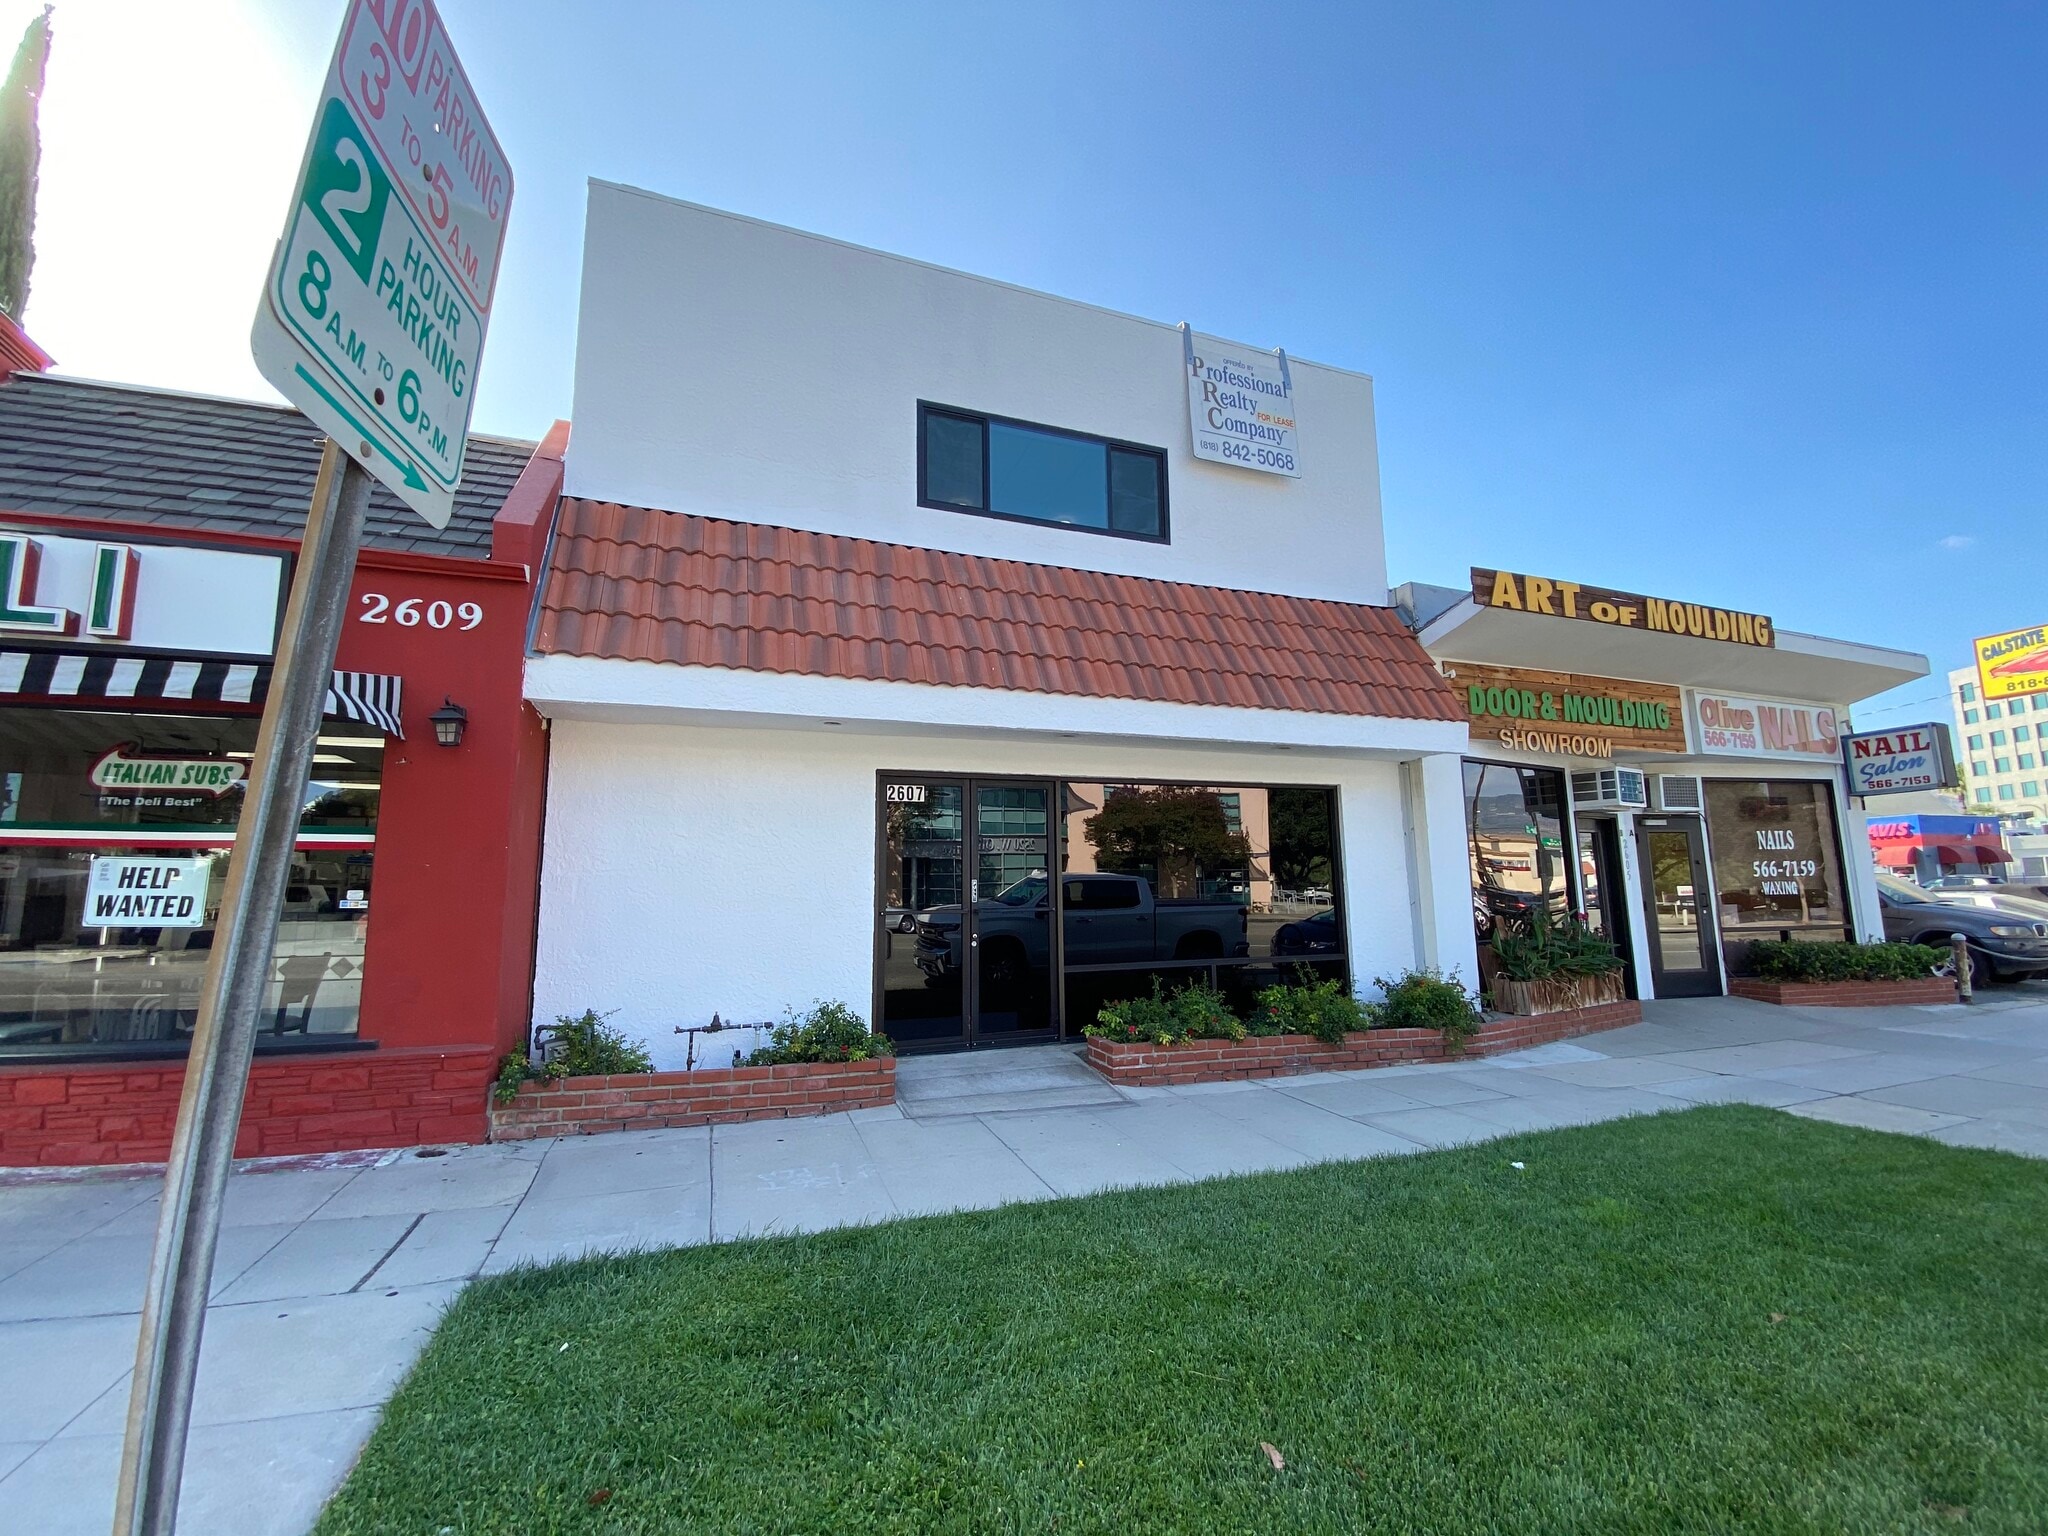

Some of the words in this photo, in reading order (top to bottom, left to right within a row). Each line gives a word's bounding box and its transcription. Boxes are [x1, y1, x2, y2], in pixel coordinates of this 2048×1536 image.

[425, 49, 503, 221] PARKING
[361, 42, 391, 120] 3
[401, 114, 422, 166] TO
[428, 161, 454, 230] 5
[448, 224, 479, 289] A.M.
[321, 137, 372, 256] 2
[403, 237, 461, 341] HOUR
[376, 257, 467, 398] PARKING
[299, 249, 332, 320] 8
[325, 311, 368, 376] A.M.
[378, 351, 394, 381] TO
[397, 369, 422, 424] 6
[418, 412, 450, 463] P.M.
[1192, 356, 1289, 399] Professional
[1202, 380, 1258, 415] Realty
[1208, 406, 1288, 446] Company
[1257, 412, 1271, 423] FOR
[1273, 416, 1294, 428] LEASE
[1200, 440, 1219, 452] (818)
[1222, 441, 1295, 471] 842-5068
[360, 592, 483, 631] 2609
[1491, 570, 1580, 618] ART
[1590, 601, 1638, 626] OF
[1646, 597, 1769, 647] MOULDING
[1981, 629, 2046, 661] CALSTATE
[1468, 684, 1535, 720] DOOR
[1540, 691, 1558, 721] &
[1563, 693, 1670, 731] MOULDING
[1701, 698, 1755, 731] Olive
[1500, 728, 1612, 758] SHOWROOM
[1704, 730, 1757, 750] 566-7159
[1757, 705, 1837, 755] NAILS
[1852, 732, 1931, 759] NAIL
[101, 763, 178, 785] ITALIAN
[181, 764, 234, 786] SUBS
[1860, 755, 1926, 783] Salon
[1868, 775, 1931, 789] 566-7159
[135, 796, 161, 807] Deli
[887, 785, 924, 801] 2607
[1756, 830, 1795, 850] NAILS
[1868, 822, 1911, 839] AVIS
[1622, 838, 1633, 881] 2605
[1753, 860, 1816, 878] 566-7159
[118, 867, 181, 889] HELP
[1762, 881, 1799, 896] WAXING
[96, 895, 195, 918] WANTED
